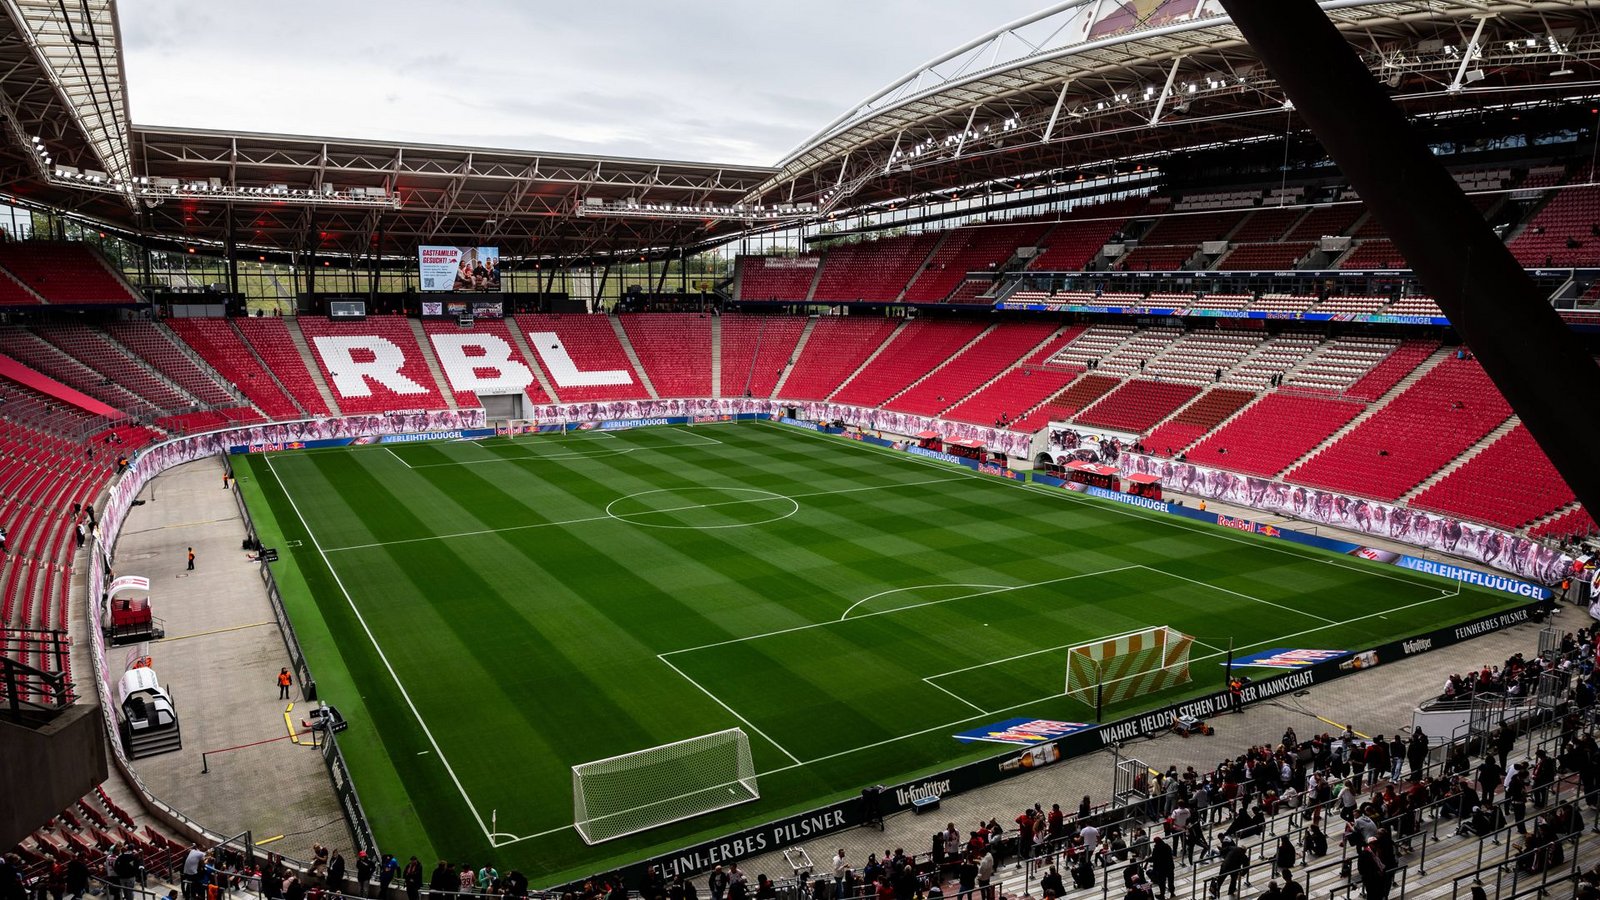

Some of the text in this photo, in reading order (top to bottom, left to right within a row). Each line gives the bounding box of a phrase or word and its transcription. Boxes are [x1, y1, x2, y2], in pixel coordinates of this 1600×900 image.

[422, 249, 458, 257] GASTFAMILIEN
[312, 331, 635, 399] RBL
[1091, 486, 1170, 513] VERLEIHTFLÜÜÜGEL
[1217, 513, 1256, 533] Red Bull
[1406, 557, 1545, 601] VERLEIHTFLÜÜÜGEL
[1455, 608, 1529, 640] FEINHERBES PILSNER
[1100, 670, 1314, 744] WAHRE HELDEN STEHEN ZU IRER MANNSCHAFT
[774, 809, 846, 844] PILSNER
